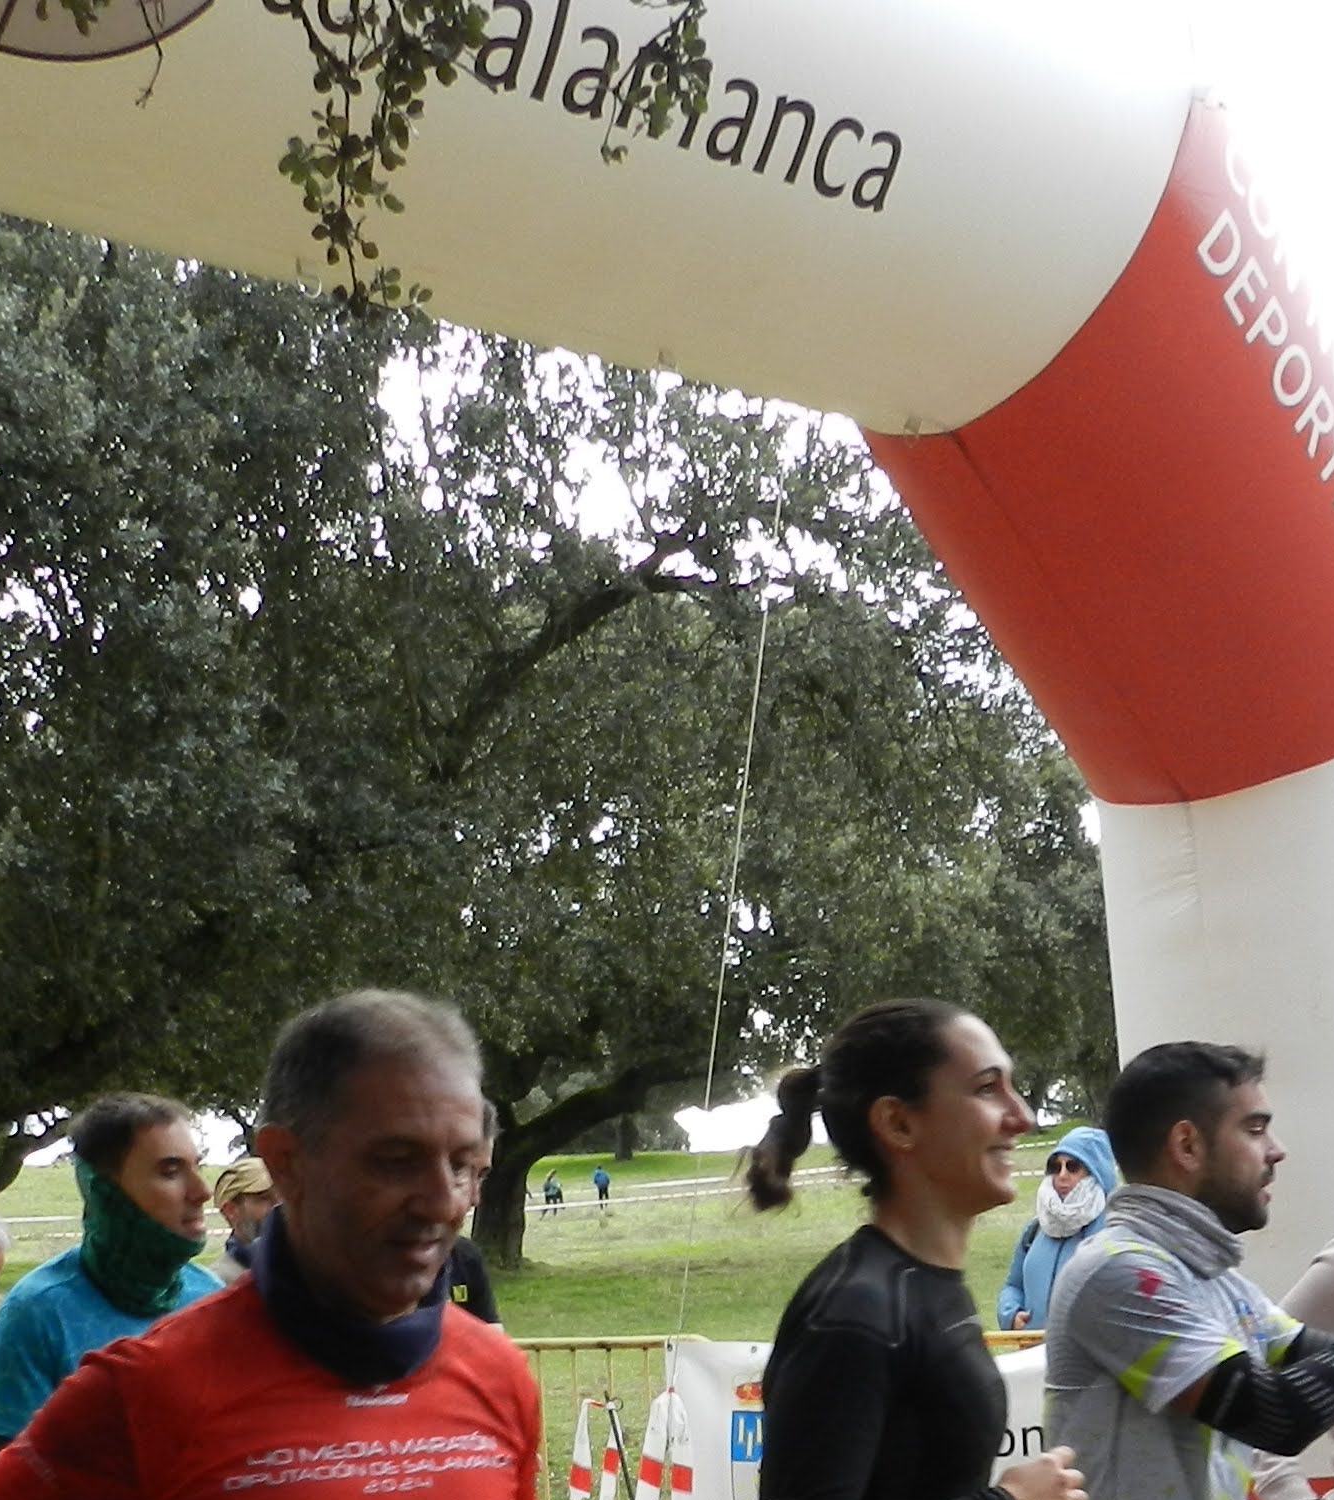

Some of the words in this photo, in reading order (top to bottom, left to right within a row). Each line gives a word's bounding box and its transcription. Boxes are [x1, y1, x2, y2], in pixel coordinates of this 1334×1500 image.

[298, 1440, 384, 1461] MEDIA
[224, 1460, 367, 1490] DIPUTACIÓN
[369, 1459, 400, 1476] DE
[362, 1476, 434, 1494] 2024
